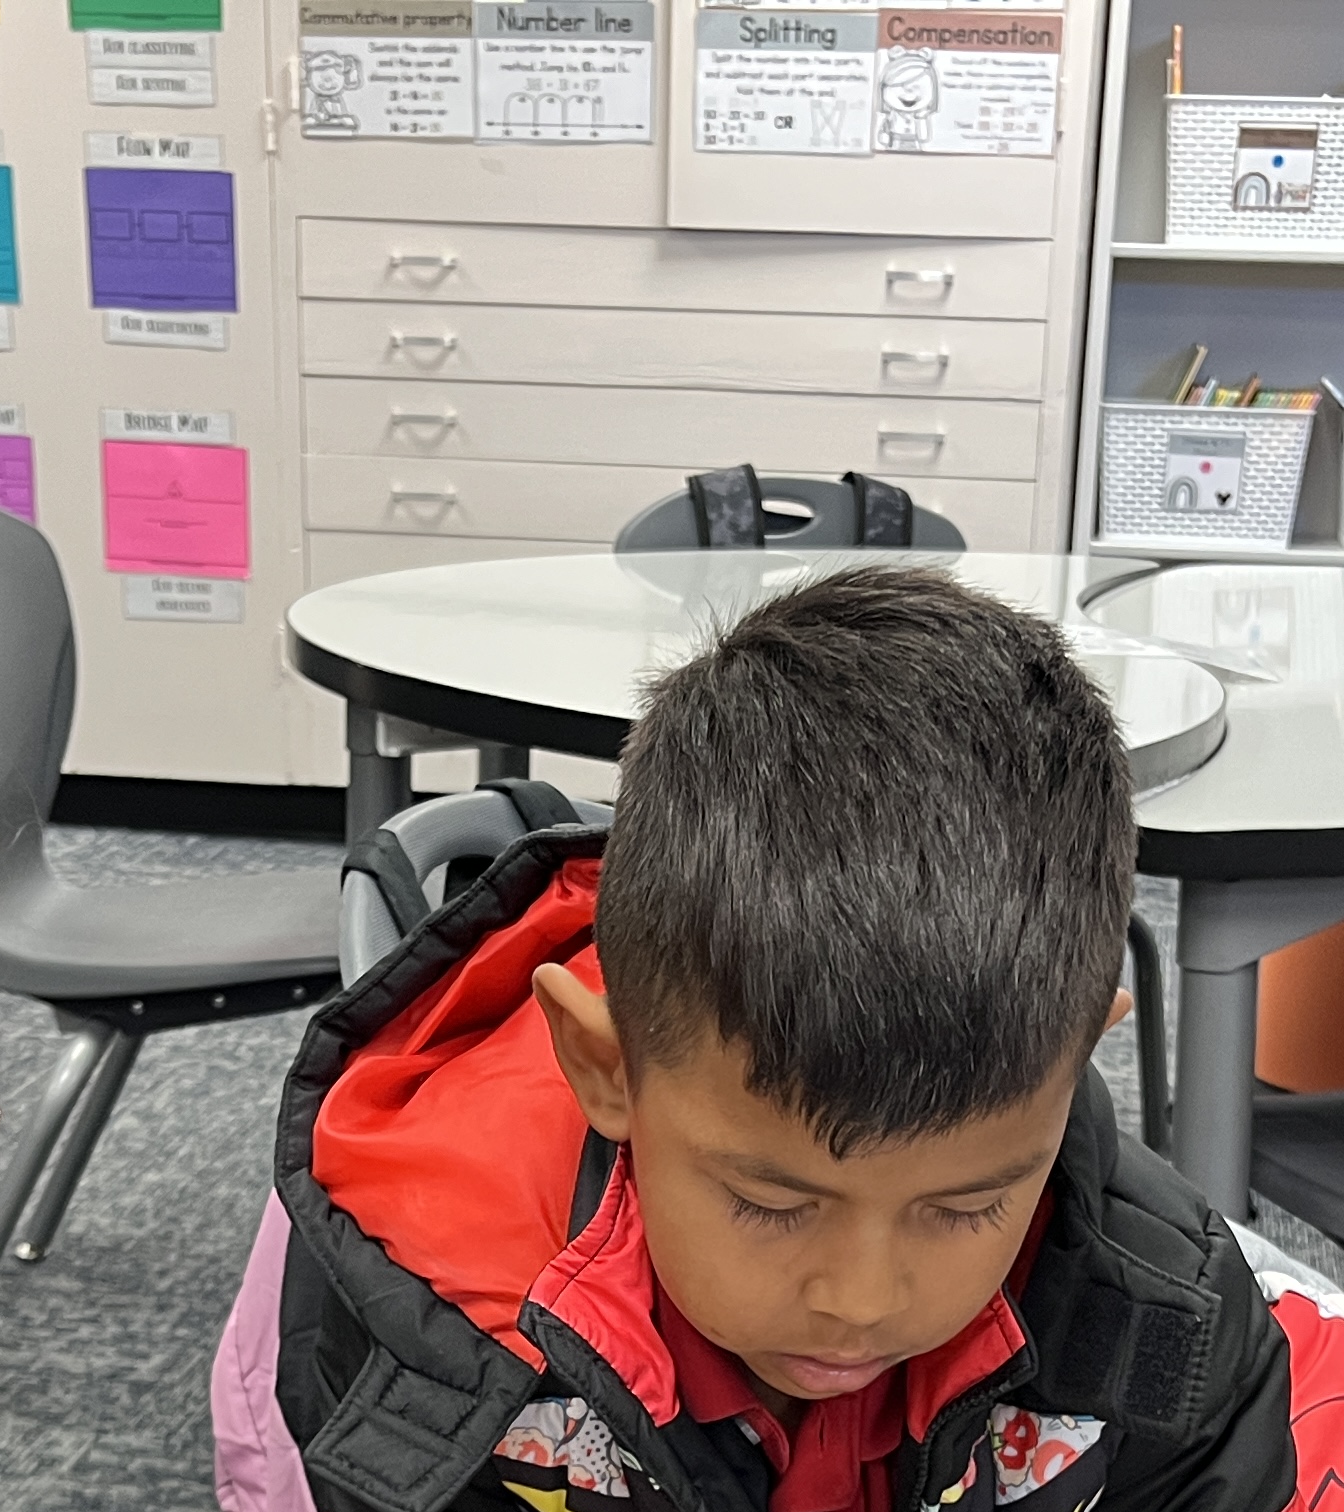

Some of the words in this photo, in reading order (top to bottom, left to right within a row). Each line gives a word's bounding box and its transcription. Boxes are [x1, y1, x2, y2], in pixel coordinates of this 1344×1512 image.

[497, 6, 586, 33] Number
[595, 7, 633, 33] line
[739, 16, 838, 50] Splitting
[887, 16, 1054, 47] Compensation
